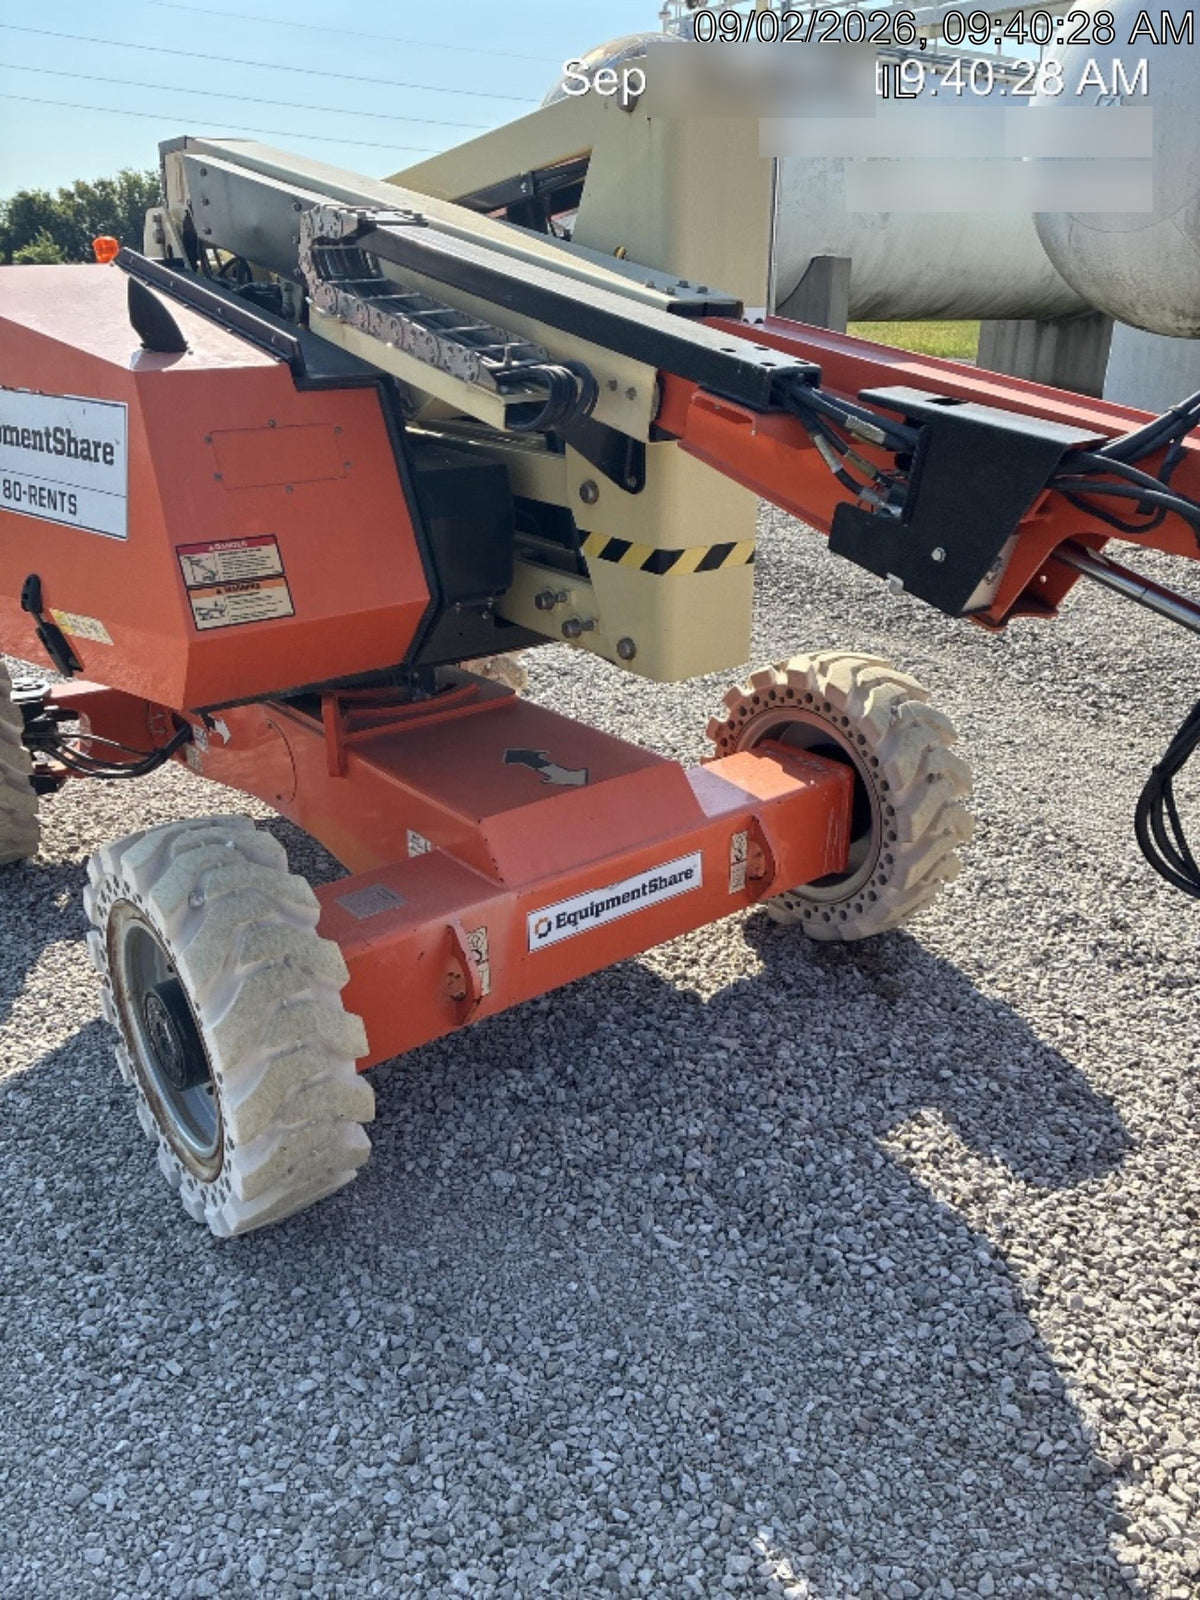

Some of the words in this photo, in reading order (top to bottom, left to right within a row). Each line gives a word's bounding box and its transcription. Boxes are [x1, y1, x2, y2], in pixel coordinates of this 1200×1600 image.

[0, 424, 115, 466] mentShare
[2, 478, 78, 516] 80-RENTS
[554, 866, 694, 929] EquipmentShare
